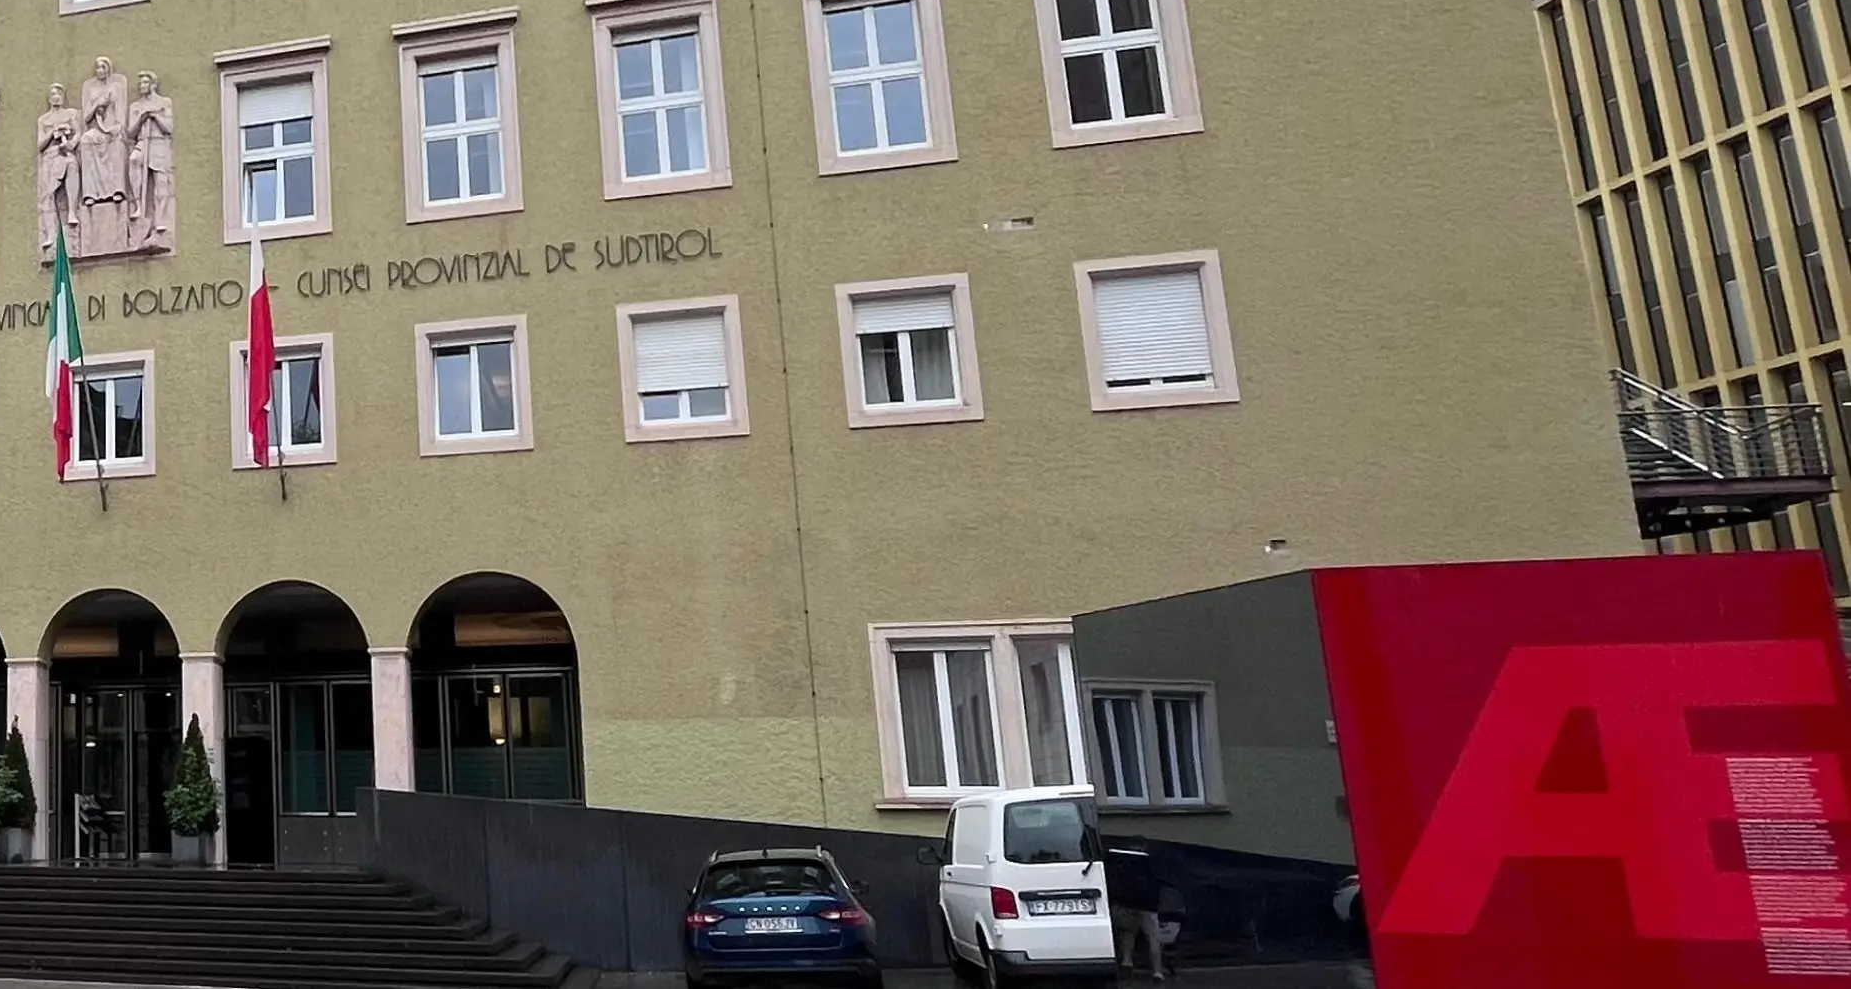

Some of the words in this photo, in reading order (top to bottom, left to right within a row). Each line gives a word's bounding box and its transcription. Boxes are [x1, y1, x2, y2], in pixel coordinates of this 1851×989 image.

[87, 293, 106, 322] DI
[122, 279, 243, 318] BOLZANO
[386, 248, 530, 290] PROVINZIAL
[544, 241, 577, 274] DE
